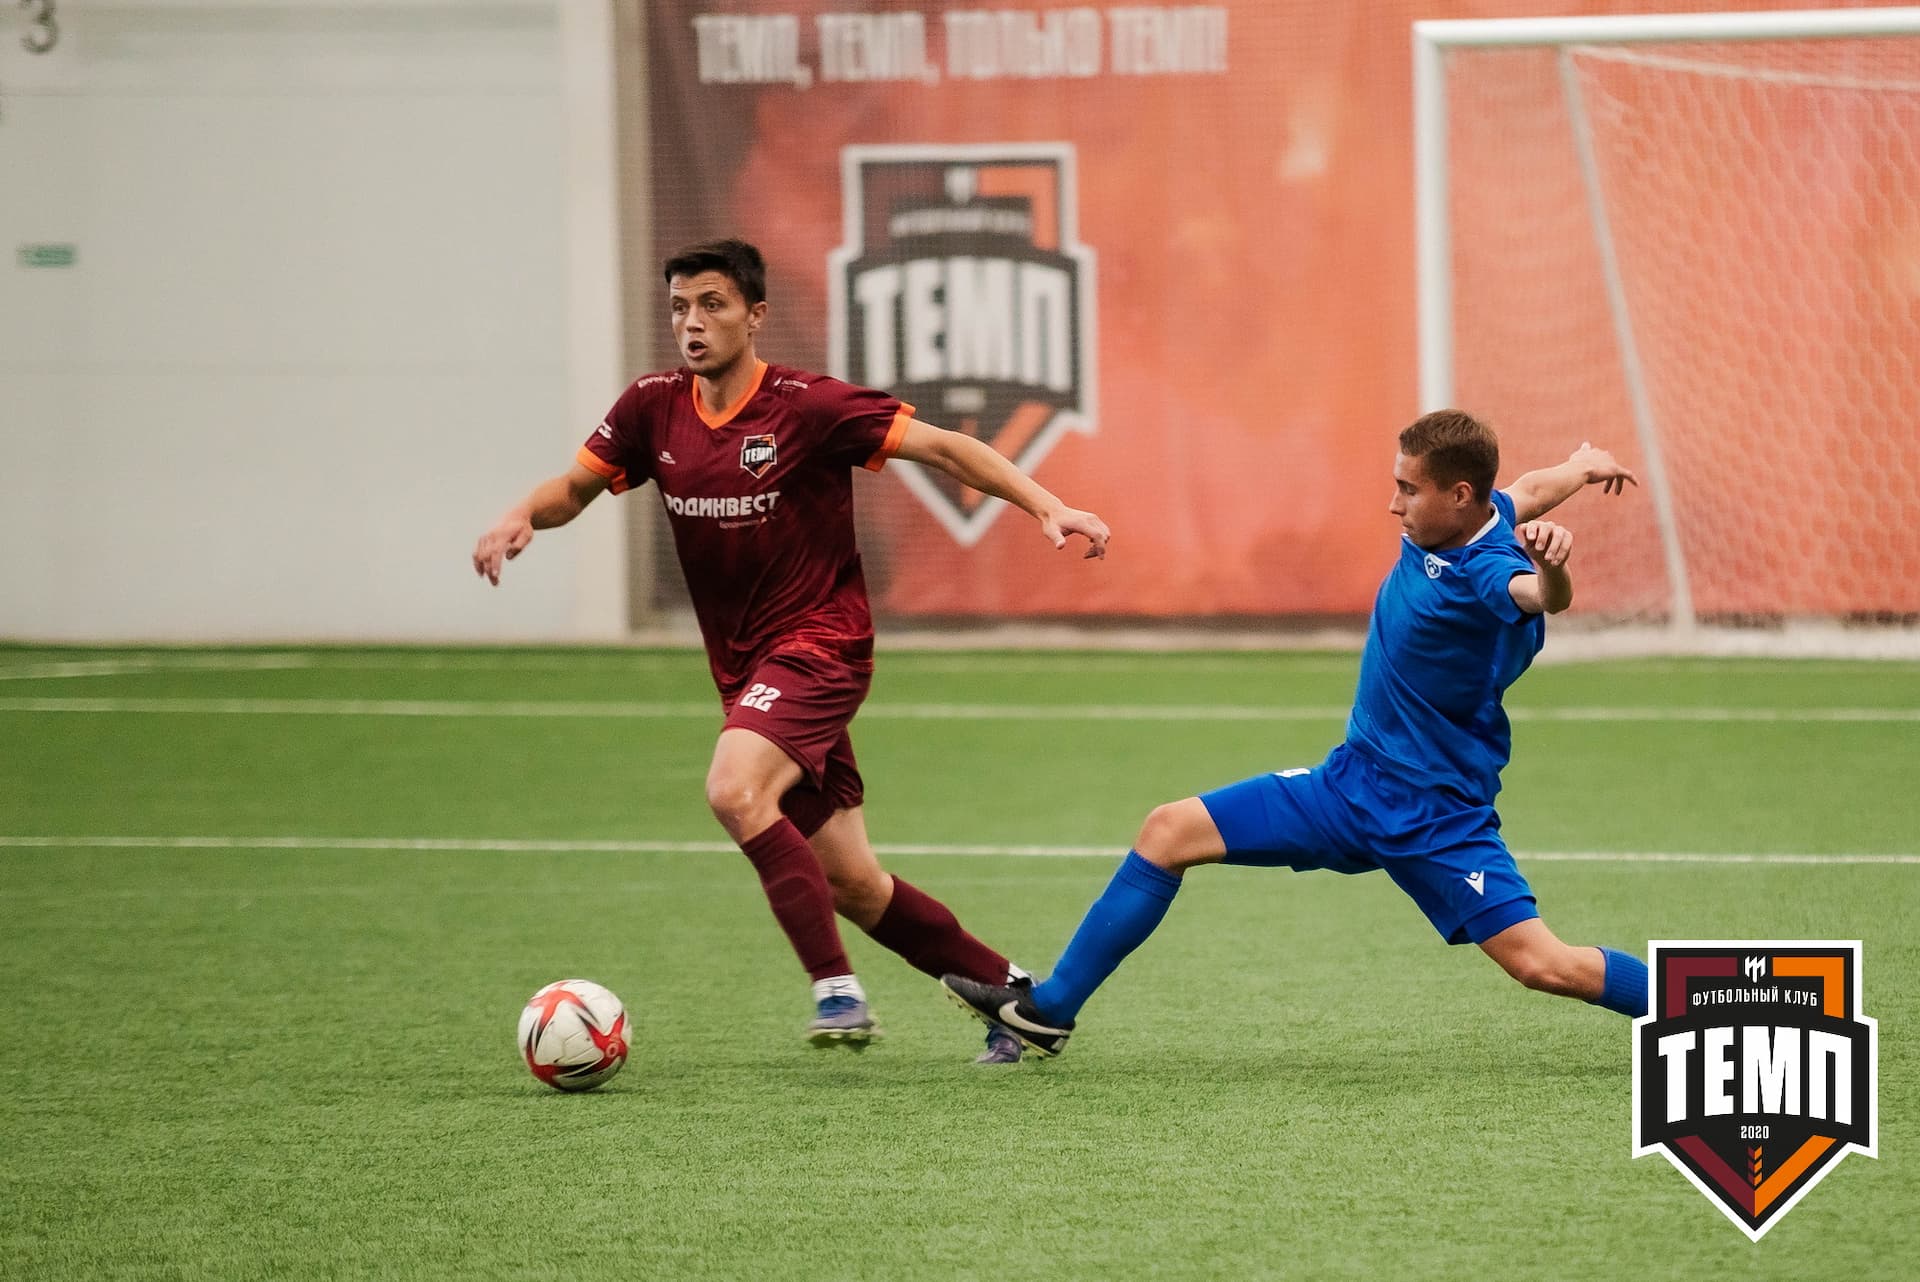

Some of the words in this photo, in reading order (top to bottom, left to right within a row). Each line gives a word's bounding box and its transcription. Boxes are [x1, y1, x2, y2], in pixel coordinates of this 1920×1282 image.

[19, 0, 58, 54] 3
[854, 256, 1071, 392] ТЕМП
[745, 447, 773, 463] ТЕМП
[740, 683, 781, 712] 22
